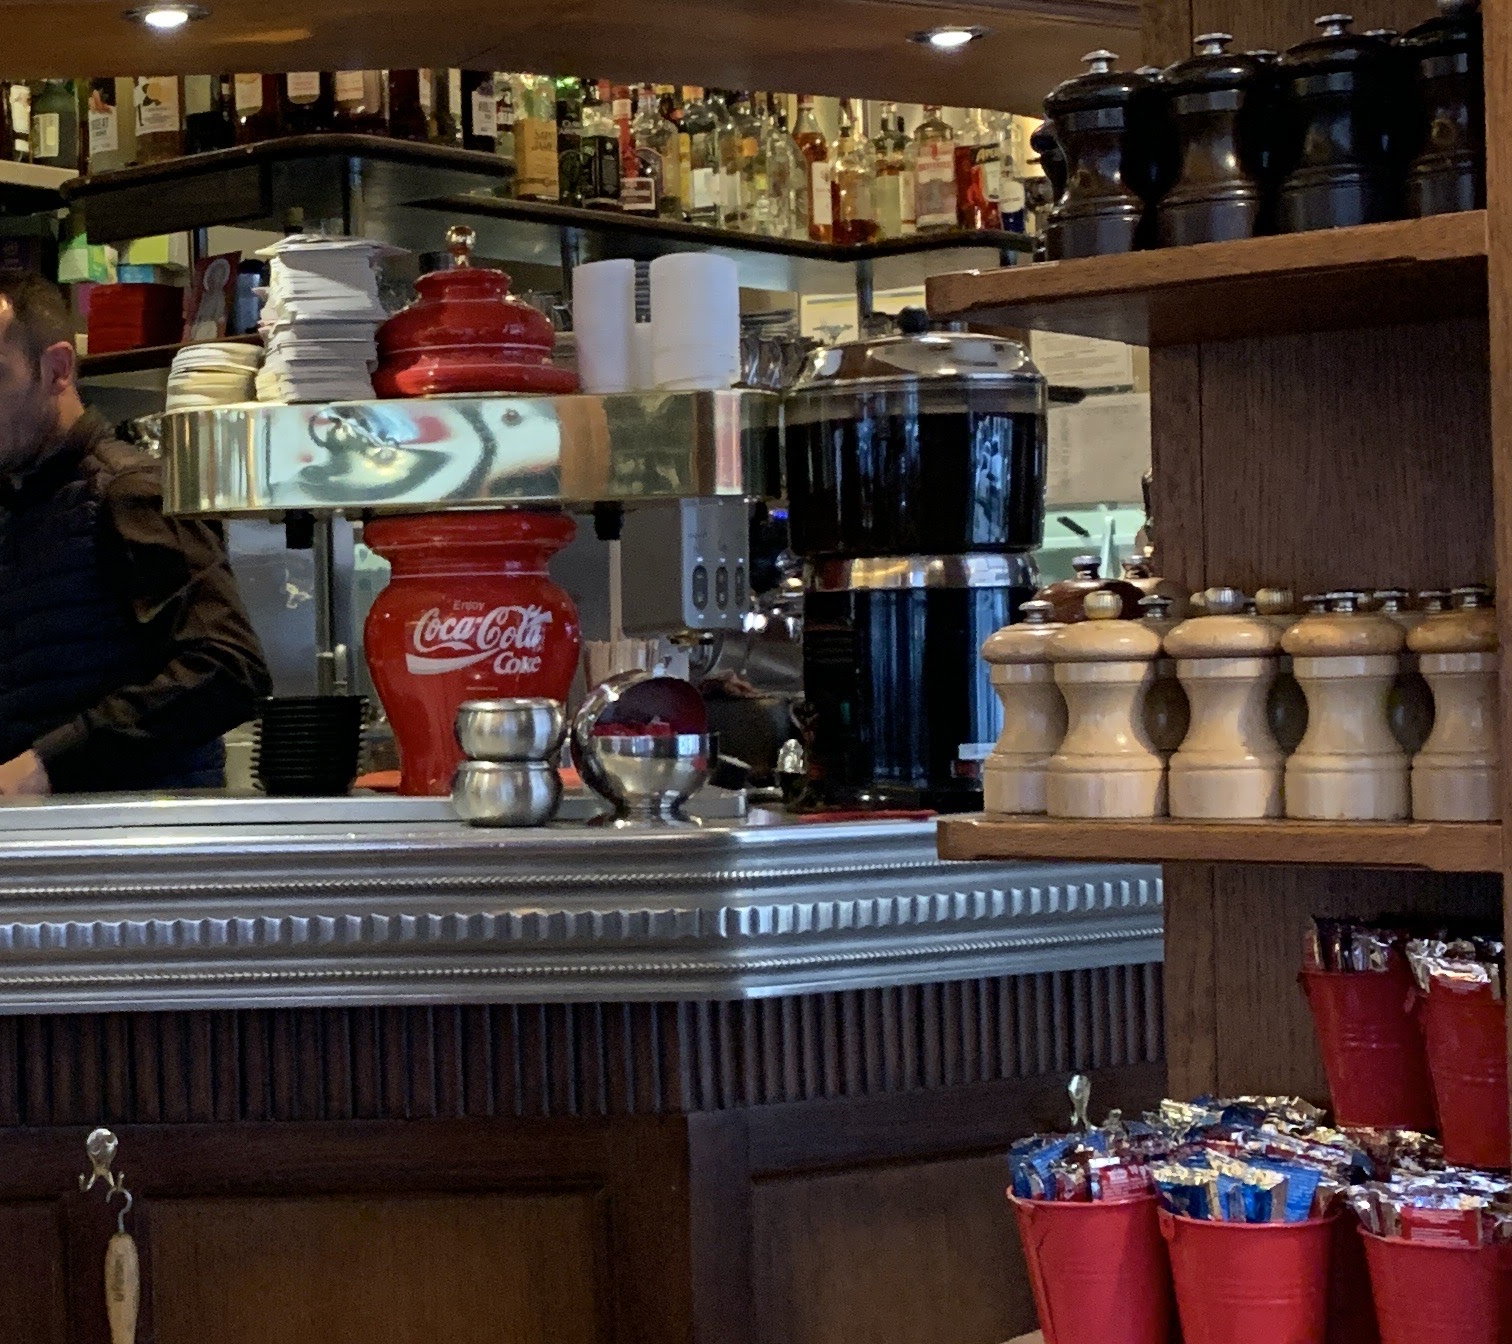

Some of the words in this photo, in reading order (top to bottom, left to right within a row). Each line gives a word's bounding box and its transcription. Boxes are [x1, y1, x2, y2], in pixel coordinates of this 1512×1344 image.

[453, 599, 485, 612] Enjoy
[413, 604, 553, 653] Coca-Cola
[493, 651, 542, 675] Coke
